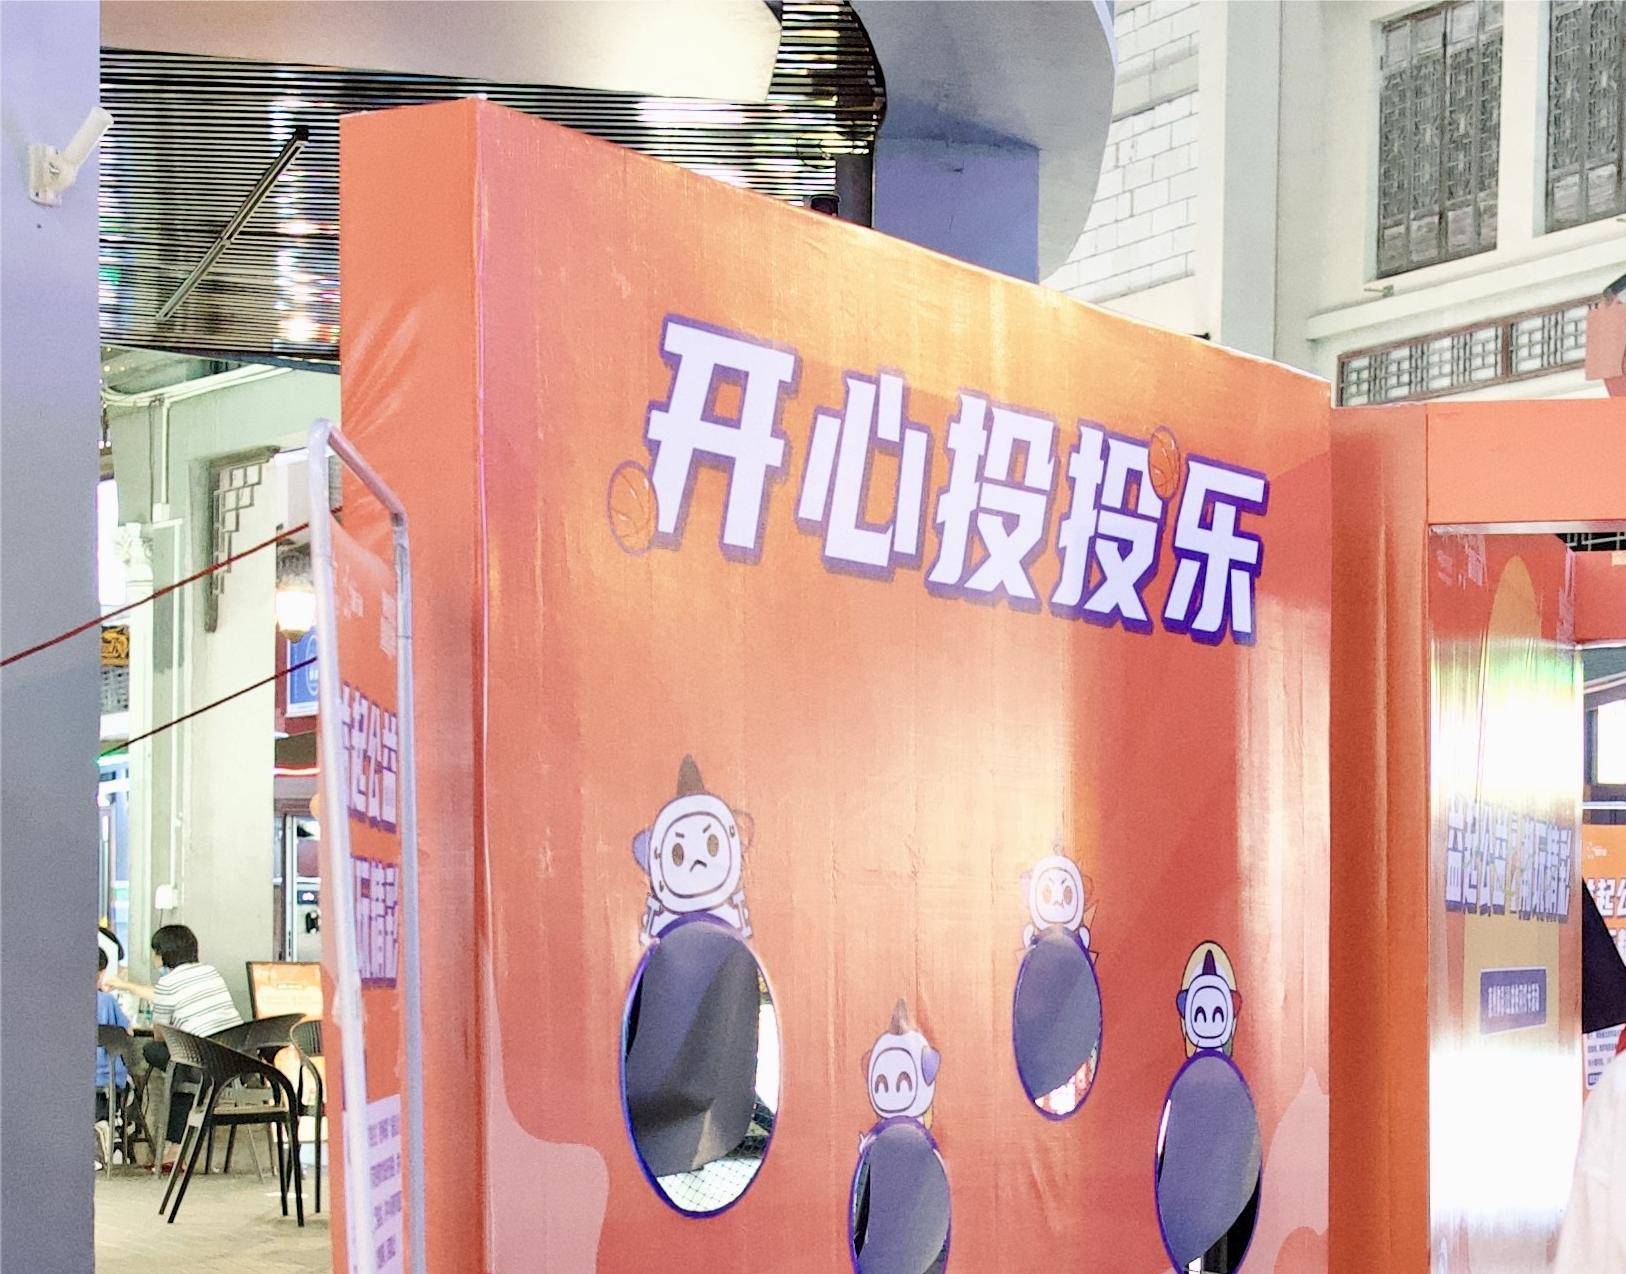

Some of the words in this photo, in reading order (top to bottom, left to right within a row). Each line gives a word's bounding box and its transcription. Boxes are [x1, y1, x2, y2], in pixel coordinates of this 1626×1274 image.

[647, 316, 1270, 644] 开心投投乐
